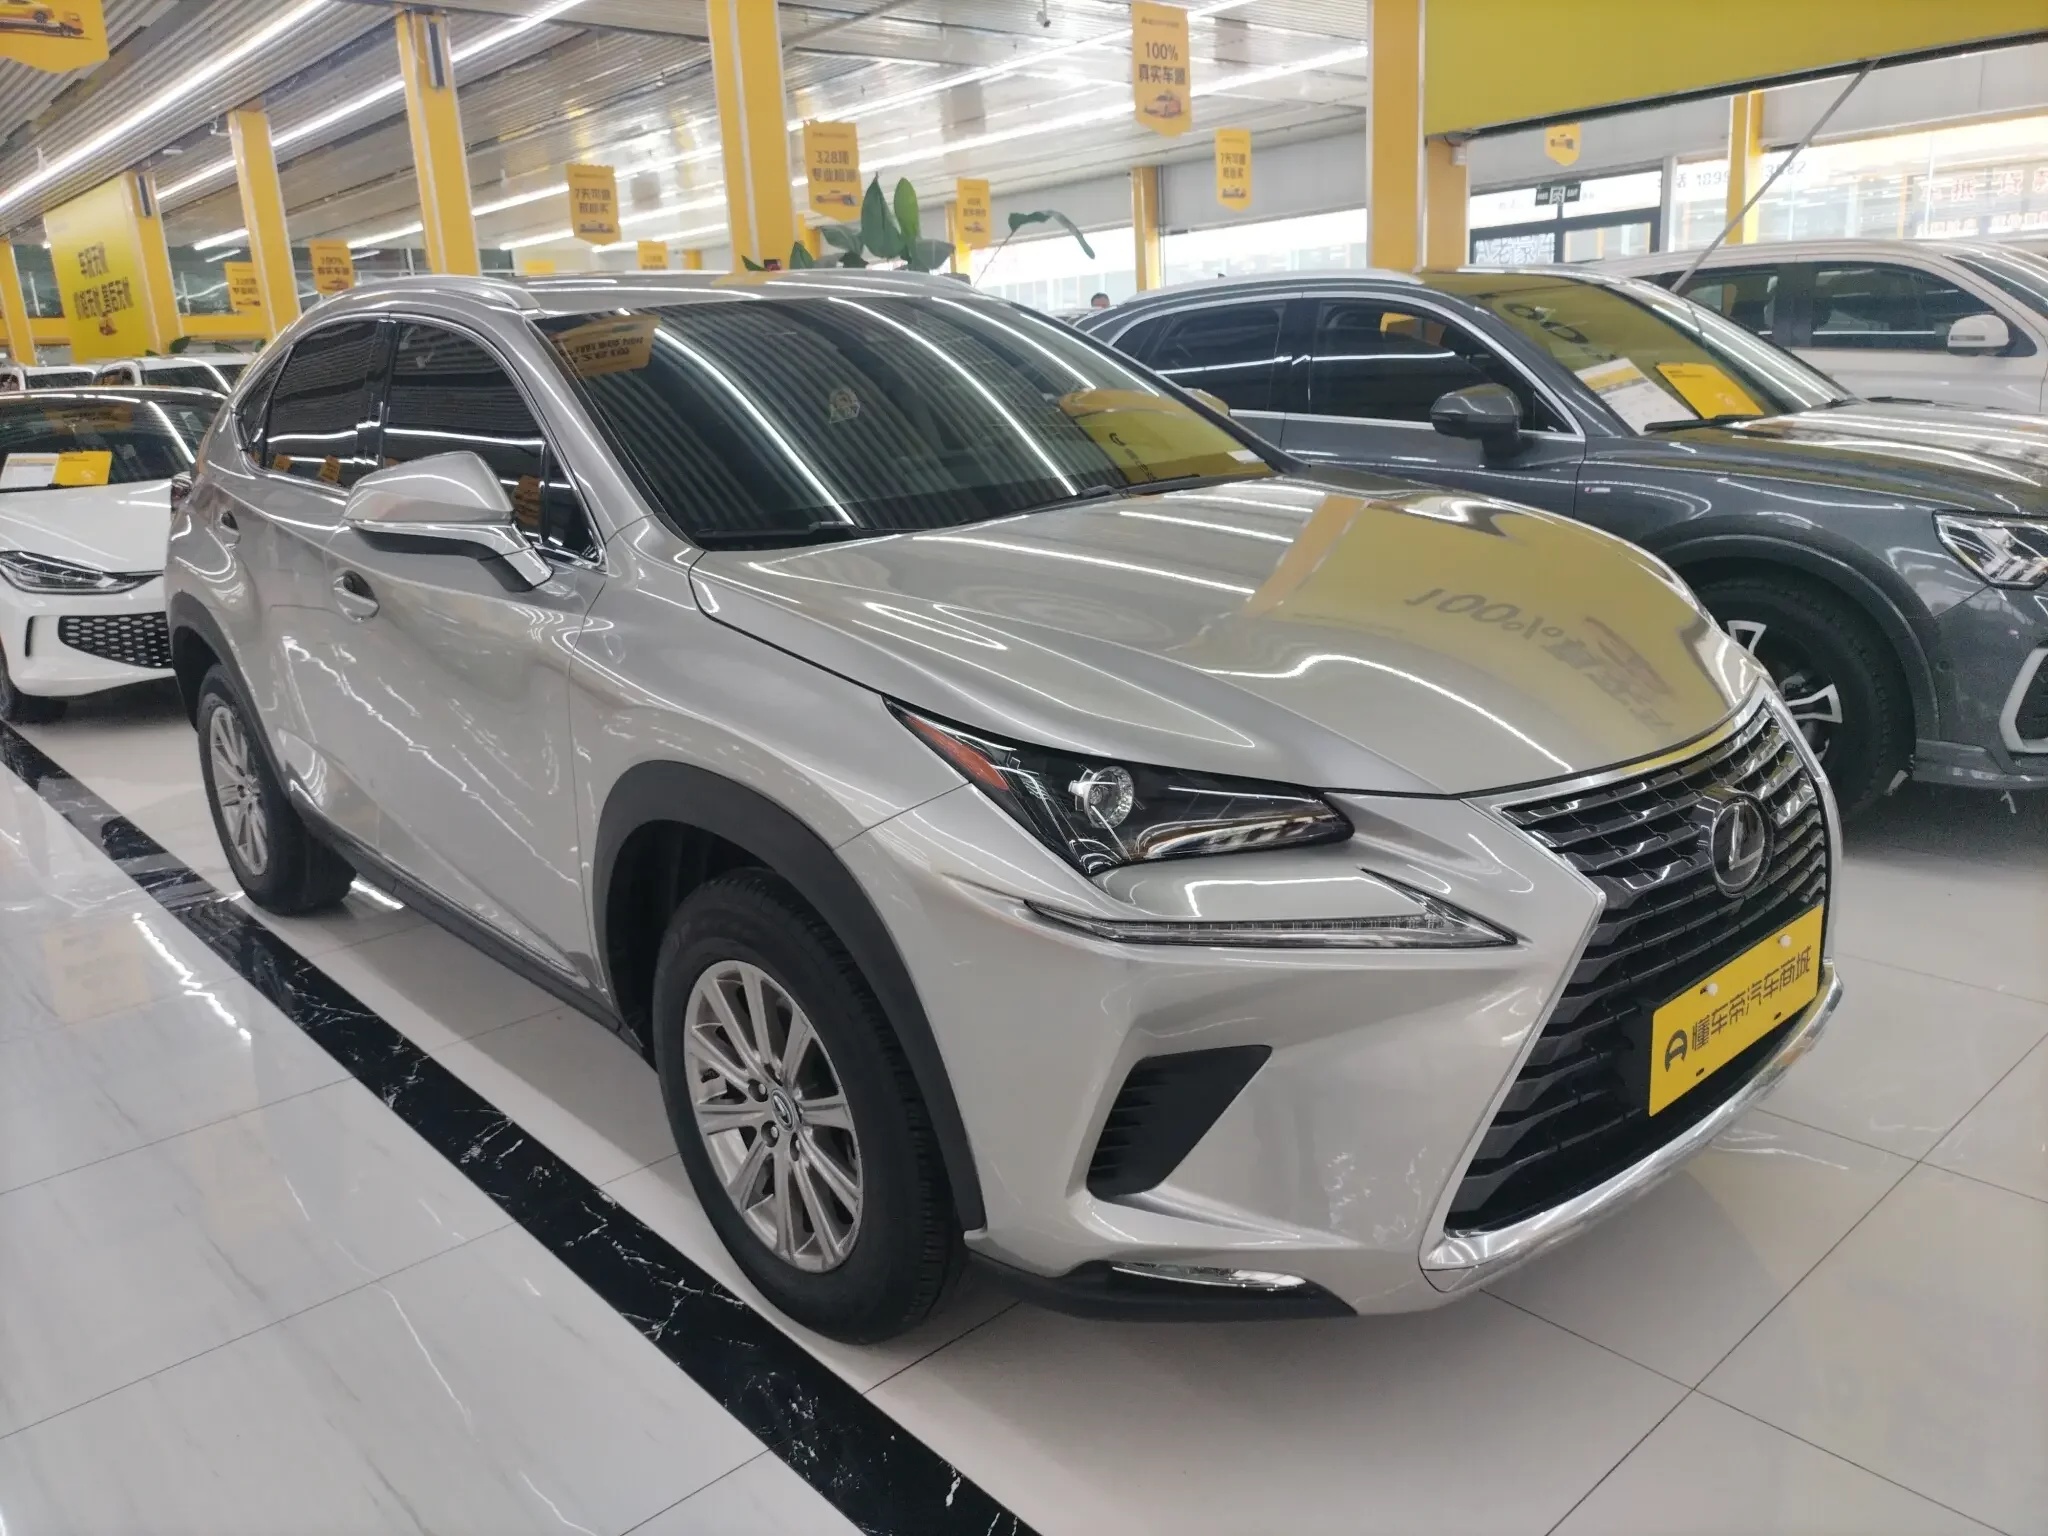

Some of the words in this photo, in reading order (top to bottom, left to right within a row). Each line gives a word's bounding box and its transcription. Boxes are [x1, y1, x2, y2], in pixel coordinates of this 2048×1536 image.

[1144, 41, 1179, 61] 100%
[1691, 944, 1812, 1052] 懂车帝汽车商城
